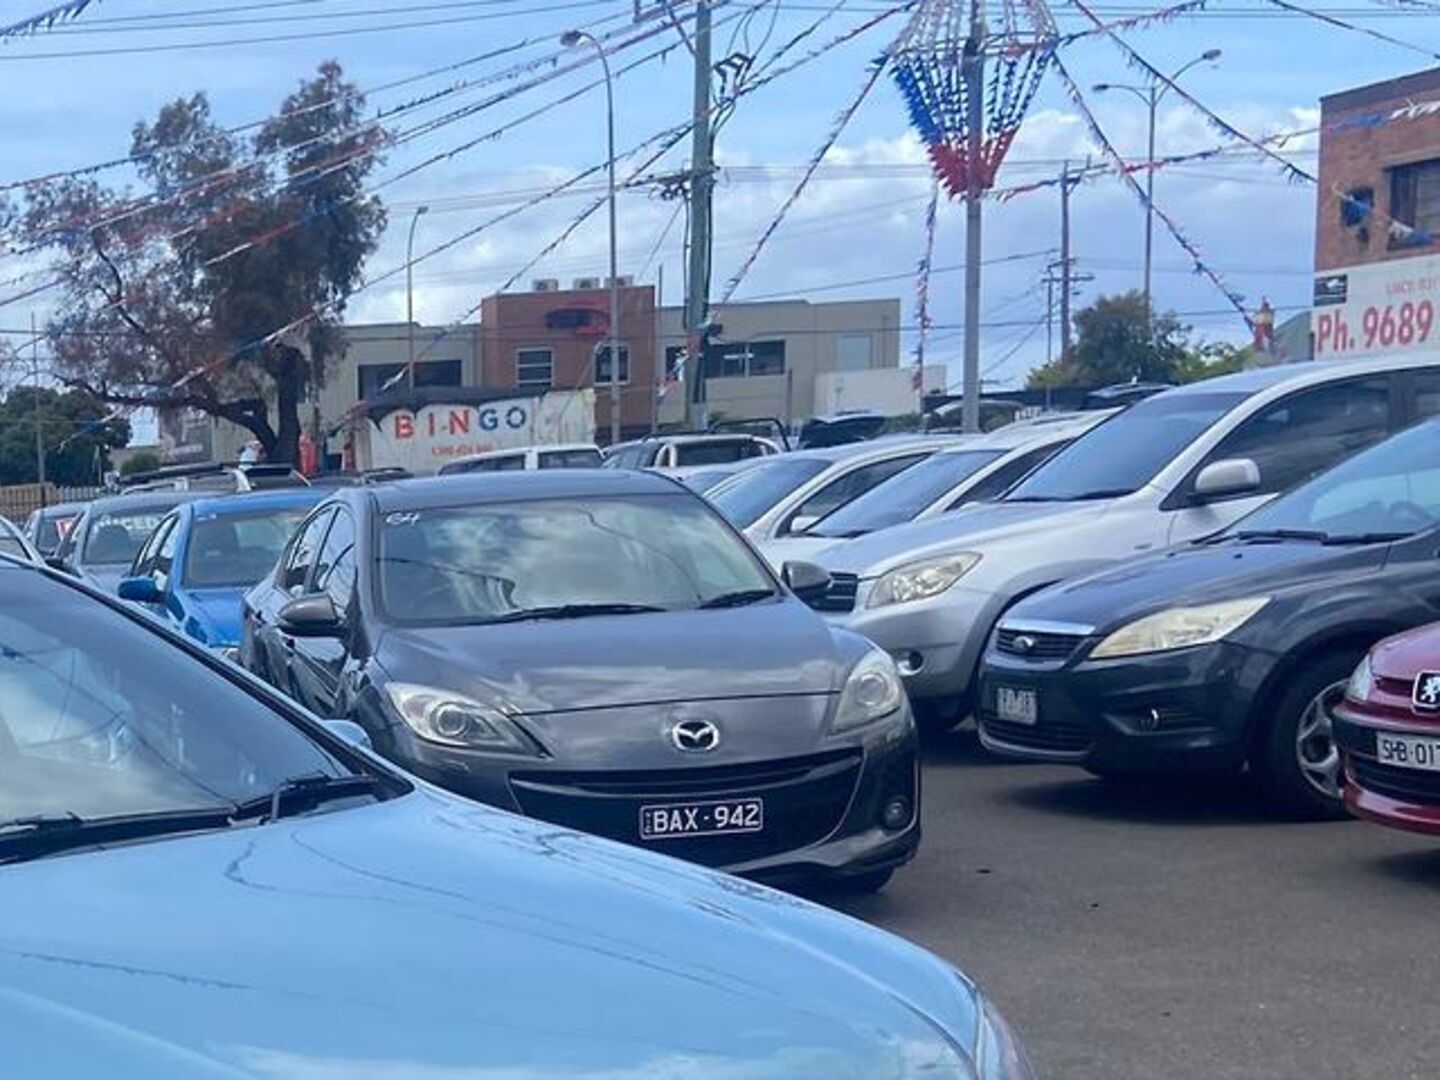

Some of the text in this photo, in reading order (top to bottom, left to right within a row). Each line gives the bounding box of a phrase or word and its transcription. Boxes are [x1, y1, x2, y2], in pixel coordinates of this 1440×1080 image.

[1318, 300, 1434, 353] Ph. 9689
[395, 406, 527, 439] BINGO
